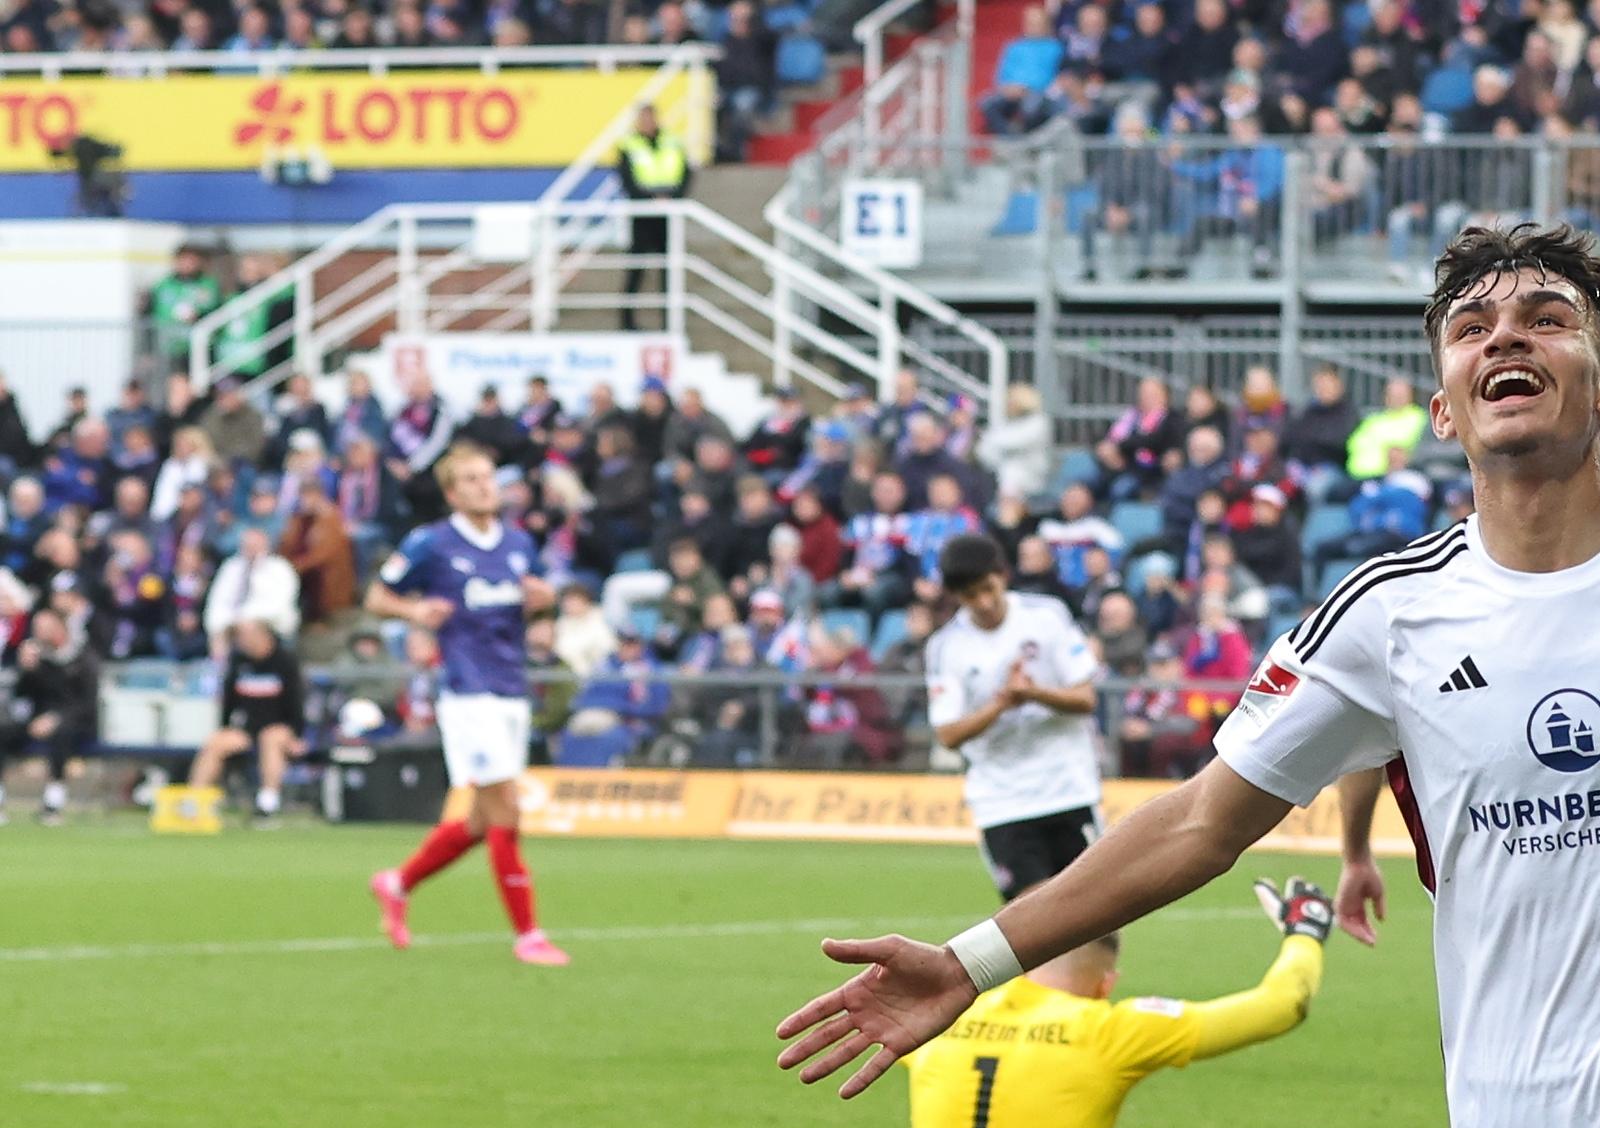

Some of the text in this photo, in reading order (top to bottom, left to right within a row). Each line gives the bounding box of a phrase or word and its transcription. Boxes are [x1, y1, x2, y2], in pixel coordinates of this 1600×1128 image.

[322, 89, 519, 142] LOTTO
[857, 193, 906, 236] E1
[732, 786, 797, 821] Ihr
[943, 1020, 1072, 1045] LSTEIN KIEL
